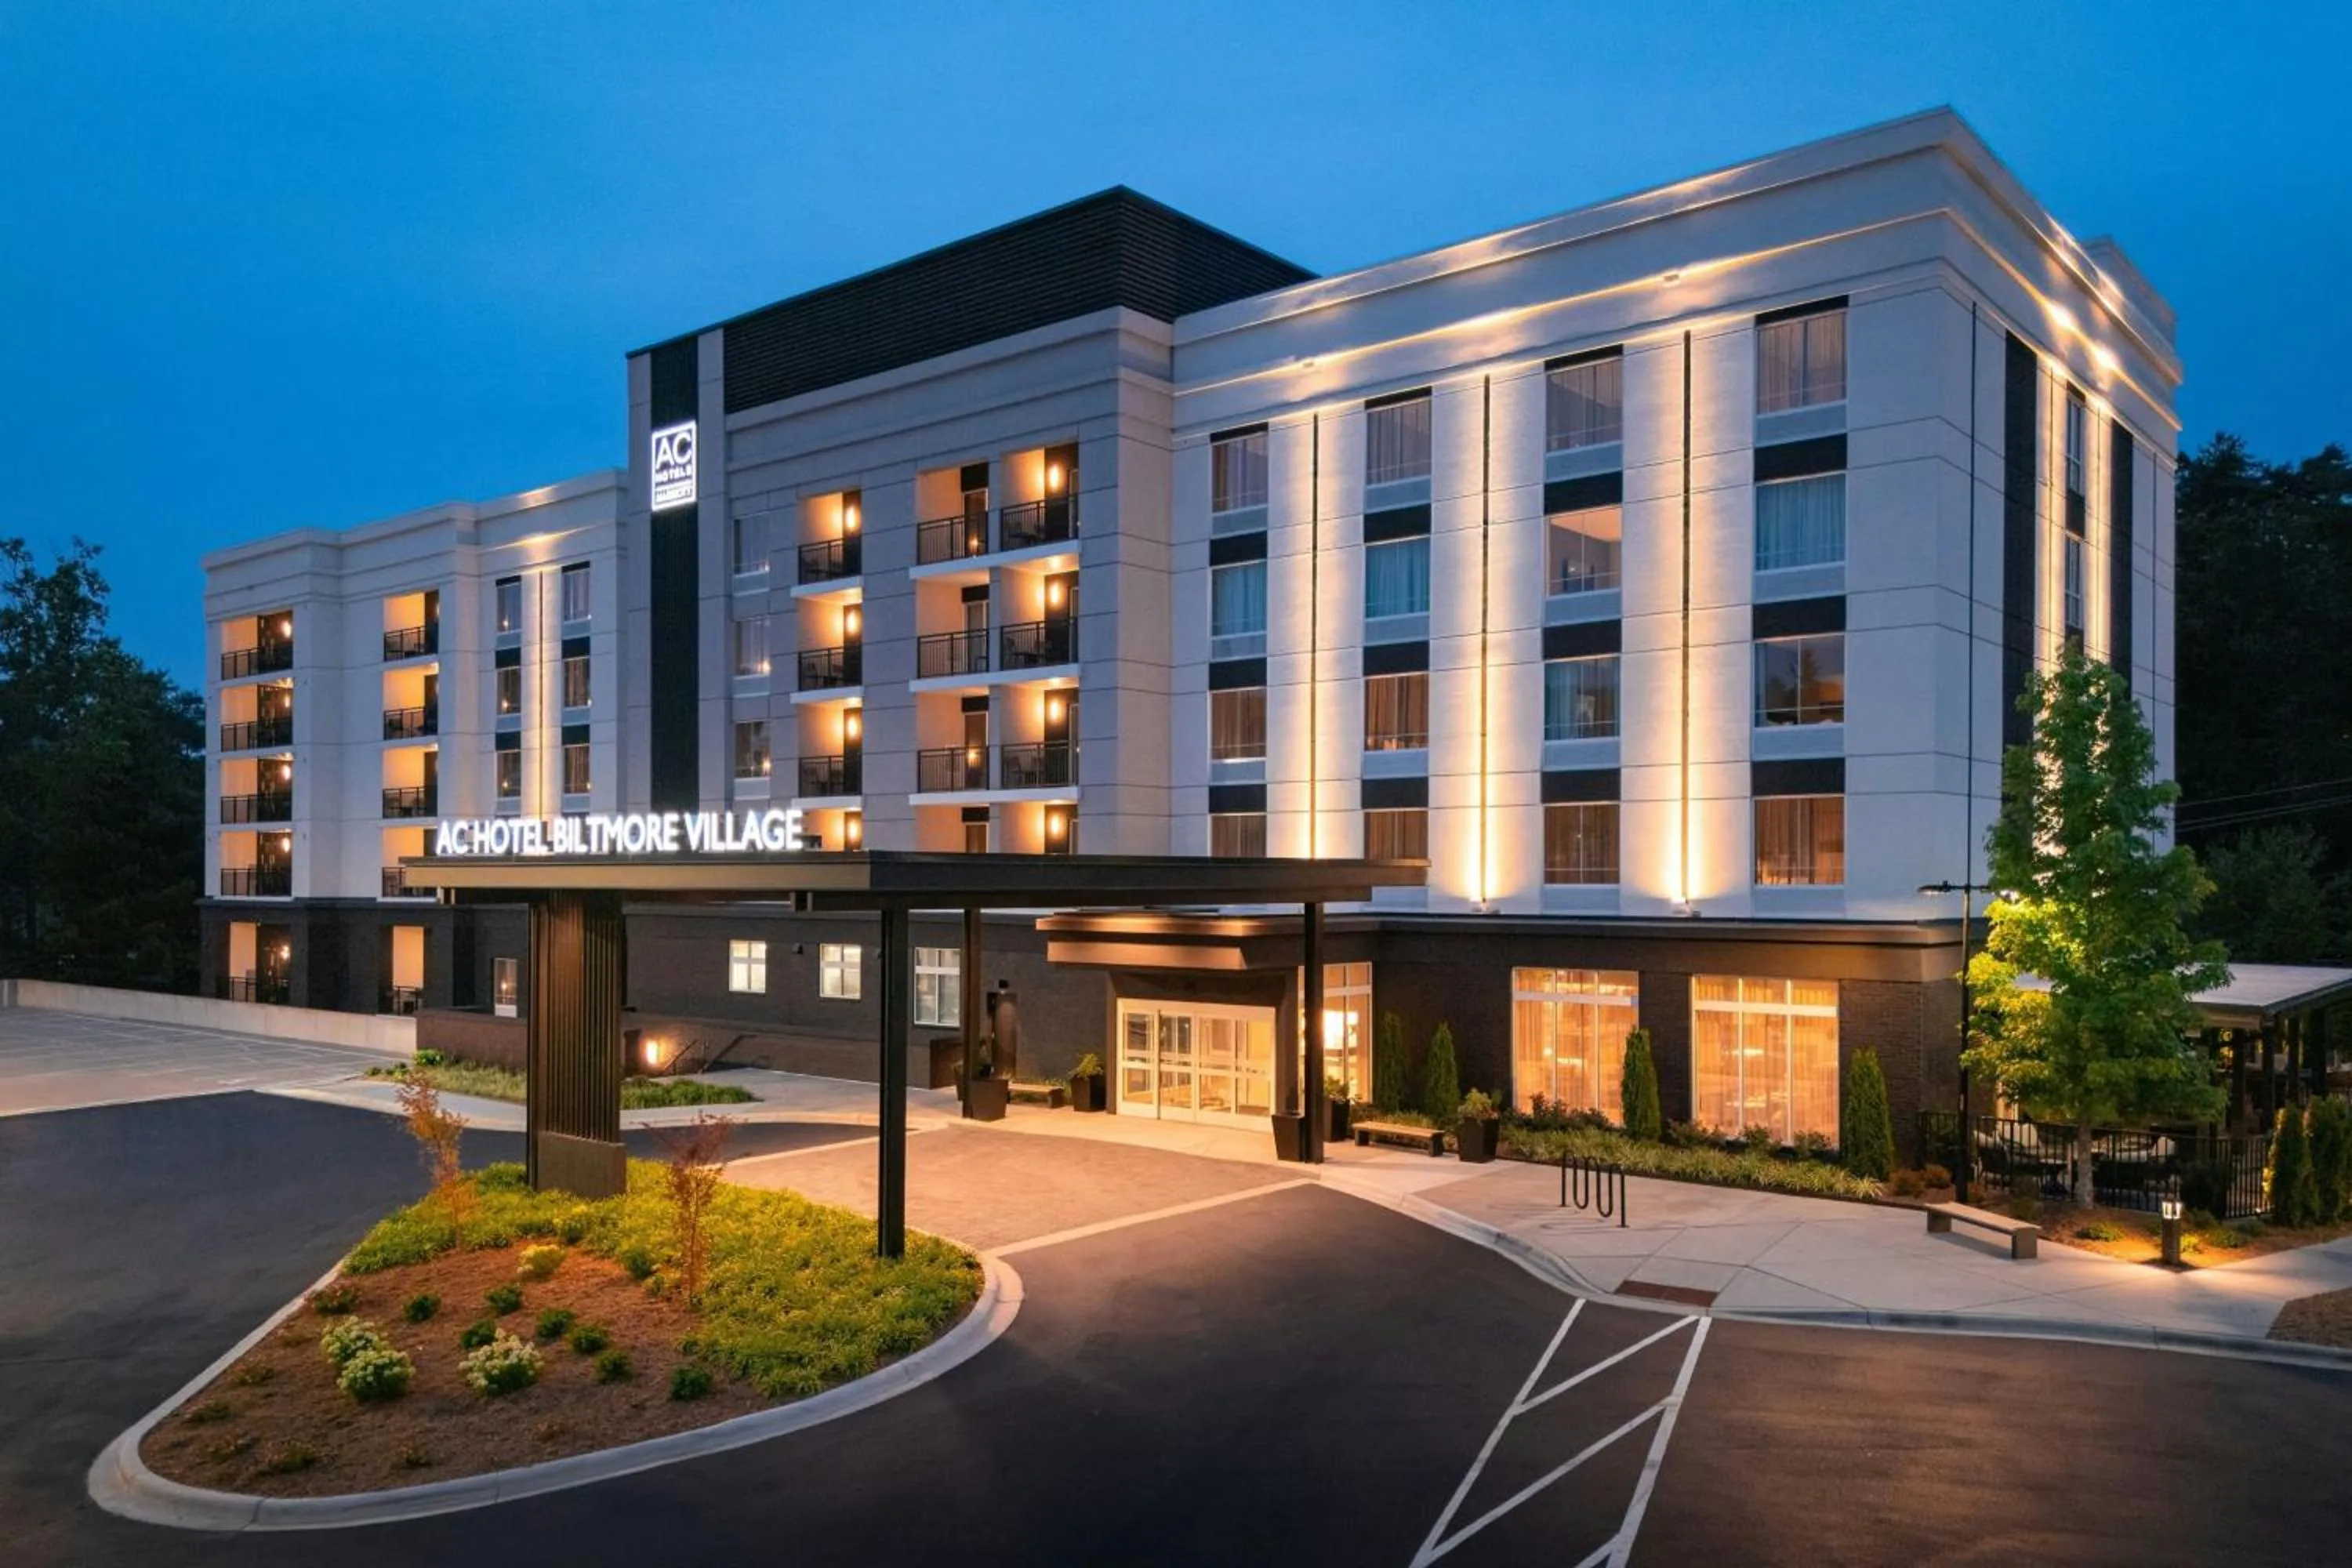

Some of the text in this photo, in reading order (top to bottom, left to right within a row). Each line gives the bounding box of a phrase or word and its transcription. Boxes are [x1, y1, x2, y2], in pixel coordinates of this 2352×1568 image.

[656, 432, 691, 470] AC
[436, 810, 803, 855] AC HOTEL BILTMORE VILLAGE
